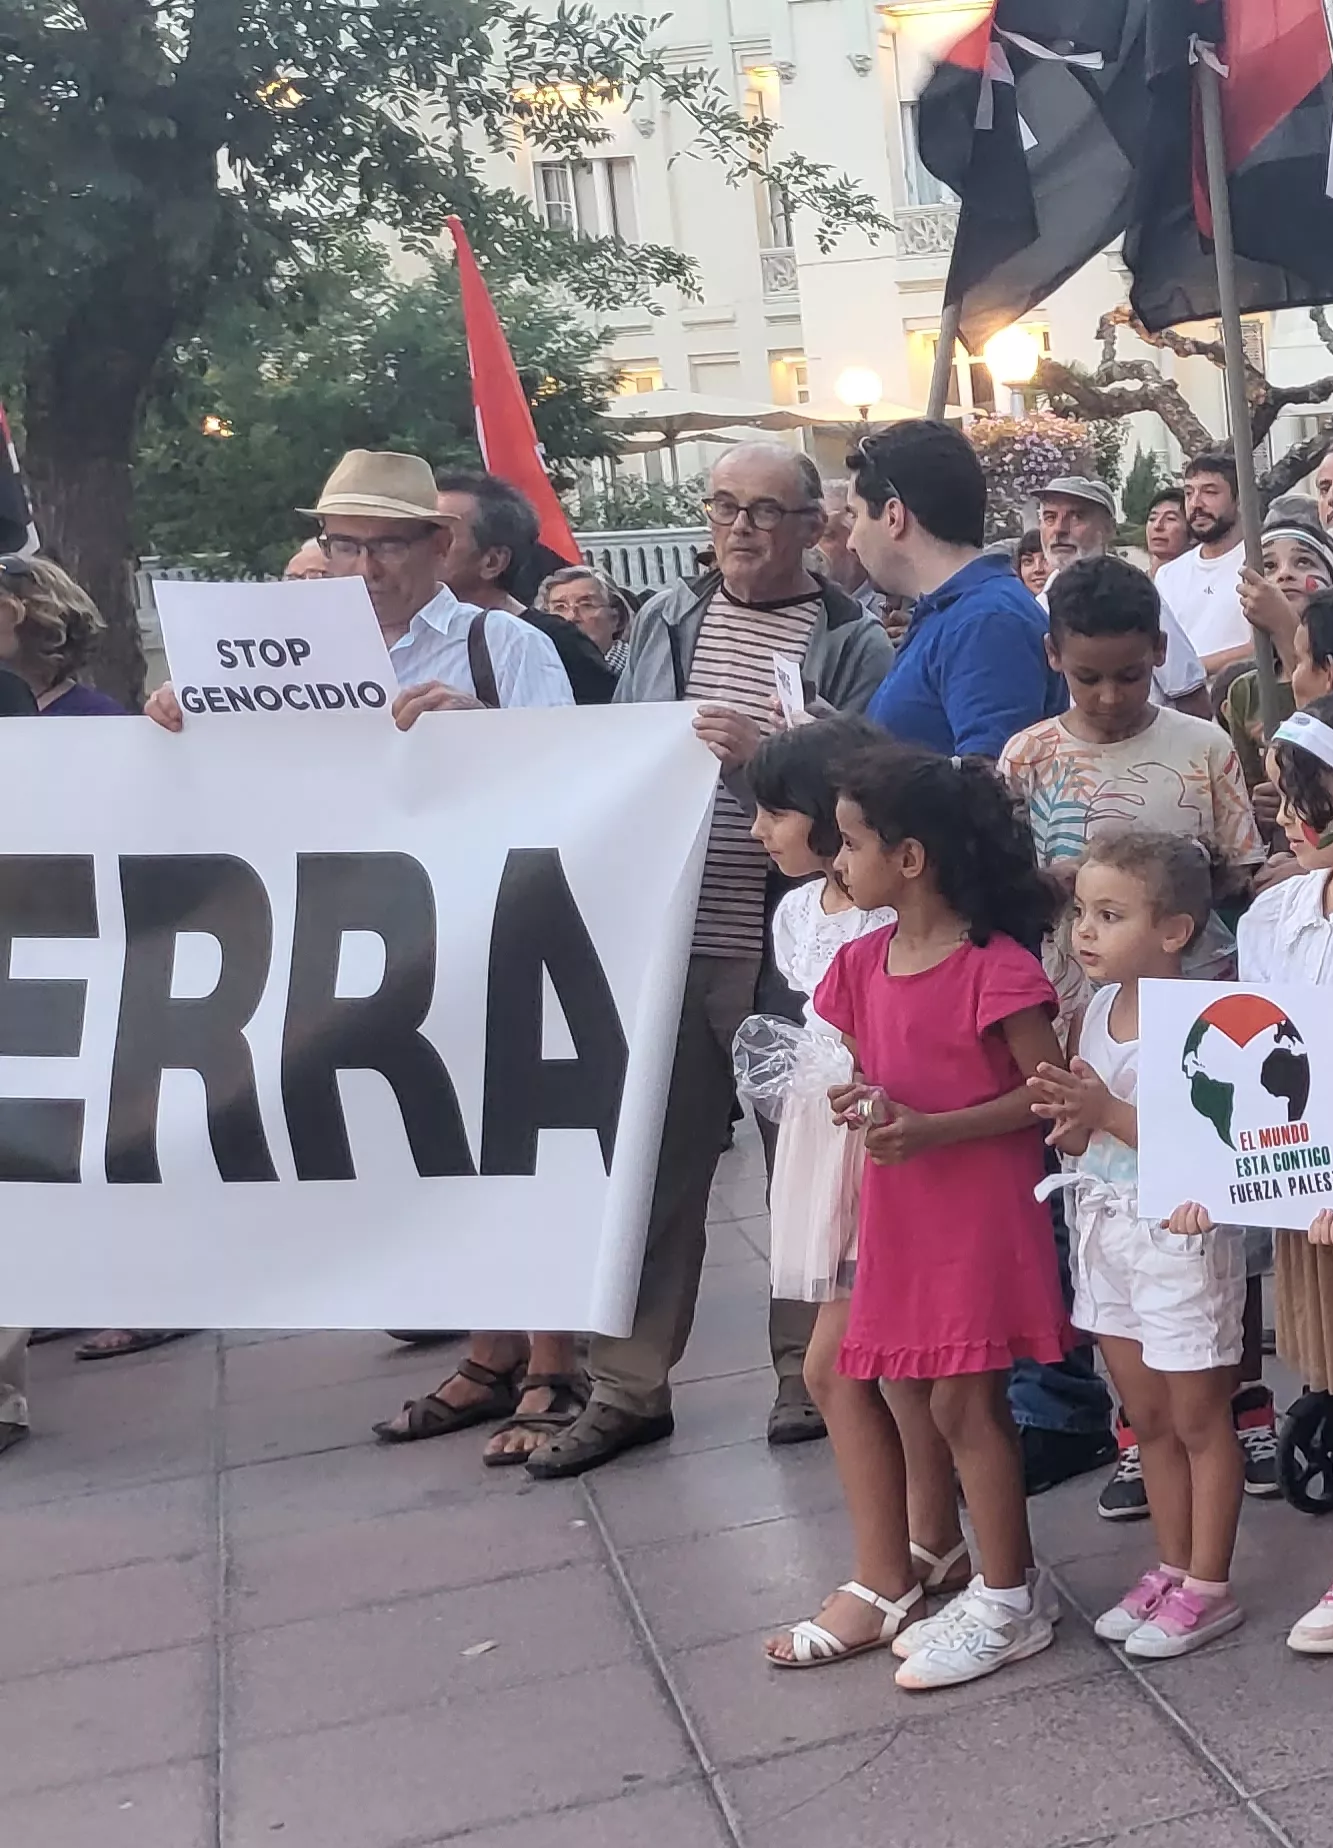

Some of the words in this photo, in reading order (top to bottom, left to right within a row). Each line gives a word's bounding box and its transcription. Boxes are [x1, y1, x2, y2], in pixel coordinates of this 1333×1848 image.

[217, 638, 311, 669] STOP
[181, 681, 387, 713] GENOCIDIO
[1239, 1130, 1257, 1152] EL
[1258, 1122, 1310, 1150] MUNDO
[1235, 1154, 1271, 1179] ESTA
[1272, 1145, 1332, 1173] CONTIGO
[1229, 1178, 1283, 1205] FUERZA
